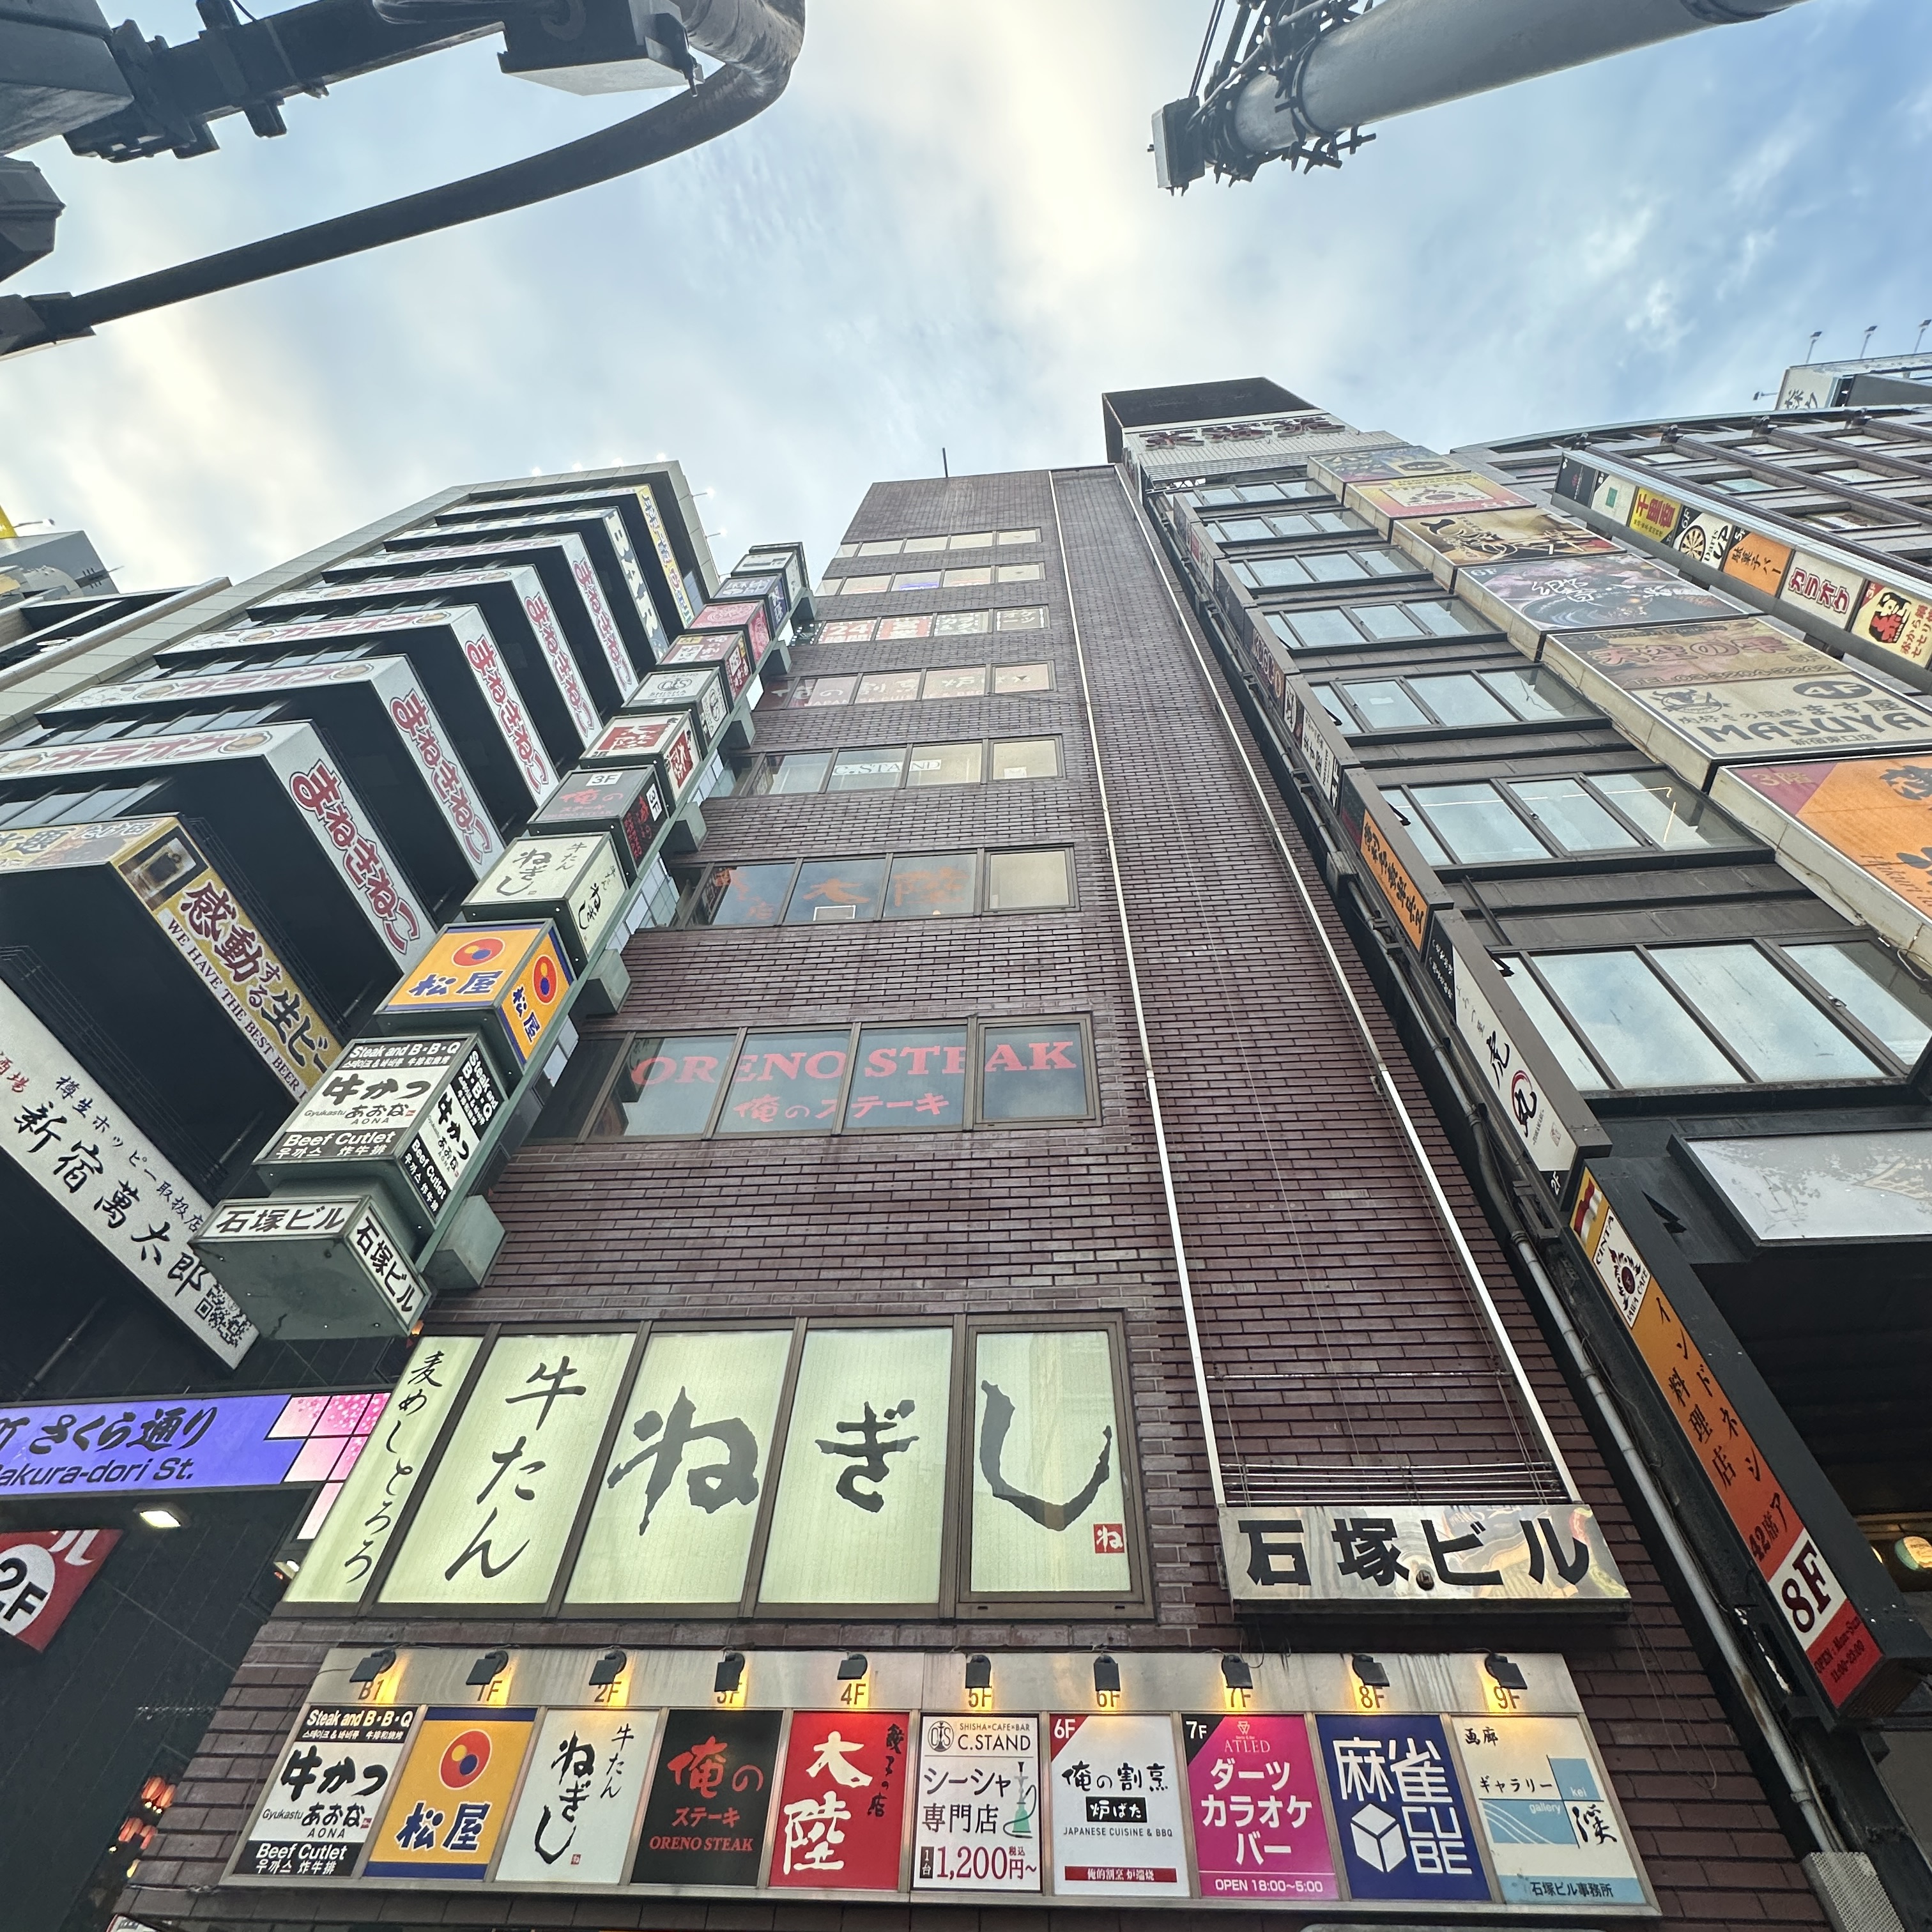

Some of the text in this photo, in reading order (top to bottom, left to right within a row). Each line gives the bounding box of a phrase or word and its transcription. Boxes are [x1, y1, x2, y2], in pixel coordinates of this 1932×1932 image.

[1681, 508, 1691, 529] 6F
[1703, 530, 1719, 562] Darts
[1731, 546, 1782, 576] 駄菓子バー
[605, 511, 658, 638] BAR
[1469, 567, 1498, 576] 6F
[1788, 567, 1851, 615] カラオケ
[273, 614, 418, 640] カラオケ
[572, 556, 632, 692] まねきねこ
[827, 624, 869, 636] 24
[524, 590, 595, 736] まねきねこ
[179, 665, 345, 695] カラオケ
[1803, 684, 1862, 695] 4F
[464, 634, 549, 794] まねきねこ
[1802, 699, 1907, 716] ます屋
[1698, 712, 1931, 743] MASUYA
[29, 732, 240, 770] カラオケ
[389, 689, 493, 864] まねきねこ
[592, 774, 618, 784] 3F
[648, 790, 661, 814] 3F
[289, 763, 419, 955] まねきねこ
[555, 841, 587, 872] 牛たん
[496, 848, 553, 896] ねぎし
[409, 970, 503, 998] 松屋
[167, 918, 302, 1092] WE HAVE THE BEST BEER
[512, 986, 540, 1044] 松屋
[349, 1045, 387, 1058] Steak
[388, 1045, 407, 1057] and
[470, 1050, 492, 1093] Steak
[486, 1090, 499, 1110] and
[631, 1050, 845, 1087] ORENO
[323, 1073, 431, 1105] 牛かつ
[1486, 1029, 1538, 1139] 虎丸
[344, 1104, 409, 1119] あおな
[351, 1117, 390, 1126] AONA
[438, 1091, 470, 1161] 牛かつ
[282, 1131, 396, 1148] Beef Cutlet
[411, 1139, 447, 1200] Beef Cutlet
[1550, 1170, 1564, 1196] 2F
[13, 1101, 202, 1297] 新宿萬太郎
[216, 1205, 347, 1233] 石塚ビル
[1596, 1215, 1615, 1266] CINTA
[356, 1217, 417, 1314] 石塚ビル
[1637, 1266, 1651, 1296] CAFE
[1657, 1296, 1791, 1533] インドネシア
[1668, 1367, 1736, 1492] 料理店
[29, 1406, 217, 1454] さくら通り
[0, 1457, 194, 1486] akura-dori St.
[445, 1354, 587, 1582] 牛たん
[608, 1380, 1112, 1536] ねぎし
[1238, 1517, 1590, 1587] 石塚ビル
[1781, 1538, 1832, 1634] 8F
[840, 1683, 867, 1705] 4F
[967, 1685, 993, 1708] 5F
[1358, 1685, 1385, 1709] 8F
[307, 1710, 341, 1727] Steak
[341, 1710, 364, 1727] and
[1054, 1718, 1077, 1739] 6F
[1185, 1721, 1208, 1740] 7F
[958, 1733, 1031, 1752] C.STAND
[1223, 1740, 1271, 1754] ATLED
[1464, 1726, 1499, 1747] 画廊
[280, 1745, 389, 1802] 牛かつ
[600, 1723, 636, 1800] 牛たん
[666, 1735, 764, 1799] 俺の
[1061, 1761, 1169, 1792] 俺の割烹
[1210, 1757, 1291, 1791] ダーツ
[1333, 1736, 1453, 1804] 麻雀
[923, 1767, 1011, 1798] シーシャ
[1479, 1775, 1553, 1794] ギャラリー
[1570, 1786, 1587, 1798] kei
[532, 1730, 595, 1866] ねぎし
[1089, 1799, 1142, 1821] 炉ばた
[1201, 1794, 1314, 1829] カラオケ
[1528, 1801, 1562, 1816] gallery
[262, 1809, 304, 1820] Gyukastu
[301, 1802, 365, 1827] あおな
[395, 1799, 494, 1853] 松屋
[671, 1807, 740, 1828] ステーキ
[922, 1804, 999, 1835] 専門店
[307, 1827, 346, 1839] AONA
[648, 1836, 753, 1851] ORENO STEAK
[1062, 1827, 1174, 1838] JAPANESE CUISINE & BBQ
[256, 1843, 348, 1860] Beef Cutlet
[1008, 1846, 1025, 1857] 税込
[1235, 1830, 1292, 1866] バー
[256, 1859, 293, 1874] 우까스
[296, 1860, 337, 1875] 炸牛排
[1215, 1878, 1249, 1892] OPEN
[1531, 1881, 1614, 1899] 石塚ビル事務所
